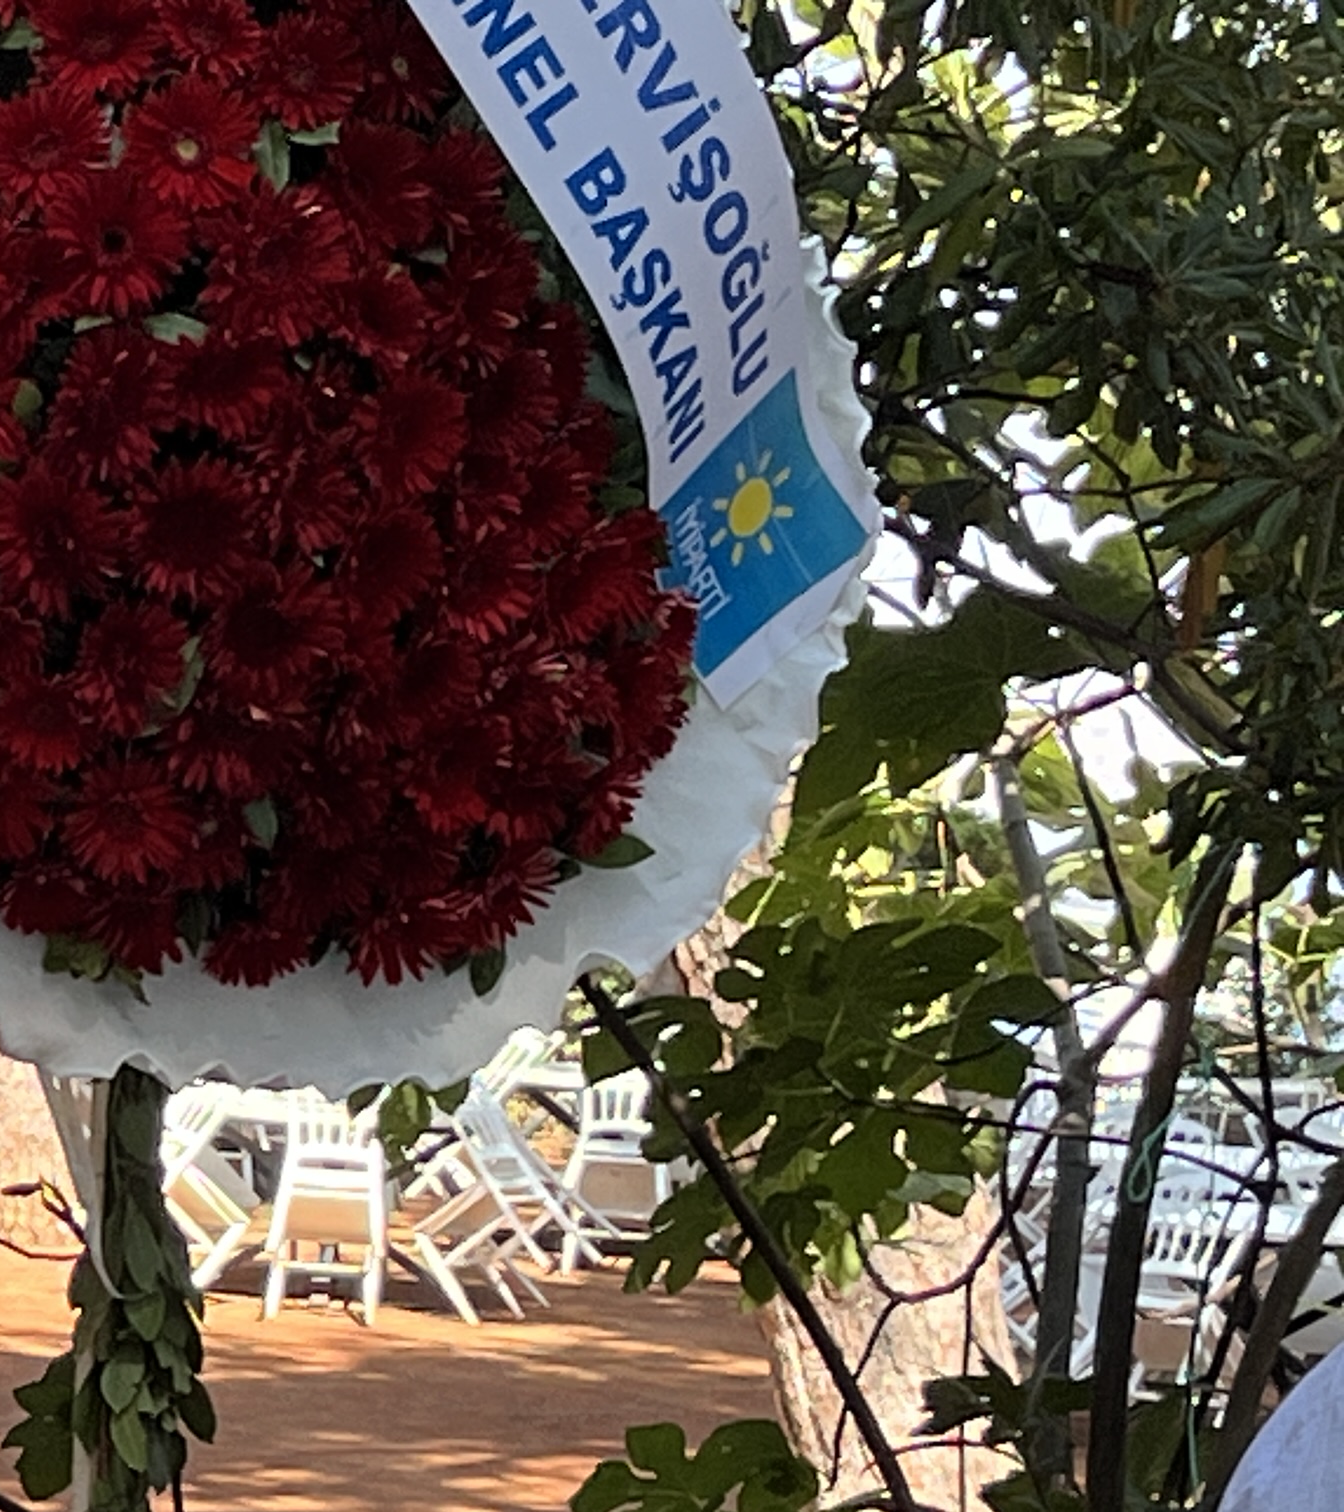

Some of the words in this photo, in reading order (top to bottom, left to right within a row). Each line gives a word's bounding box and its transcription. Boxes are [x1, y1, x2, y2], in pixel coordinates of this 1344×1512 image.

[451, 0, 579, 152] NEL
[564, 147, 706, 463] BAŞKANI
[580, 0, 770, 396] RVİŞOĞLU
